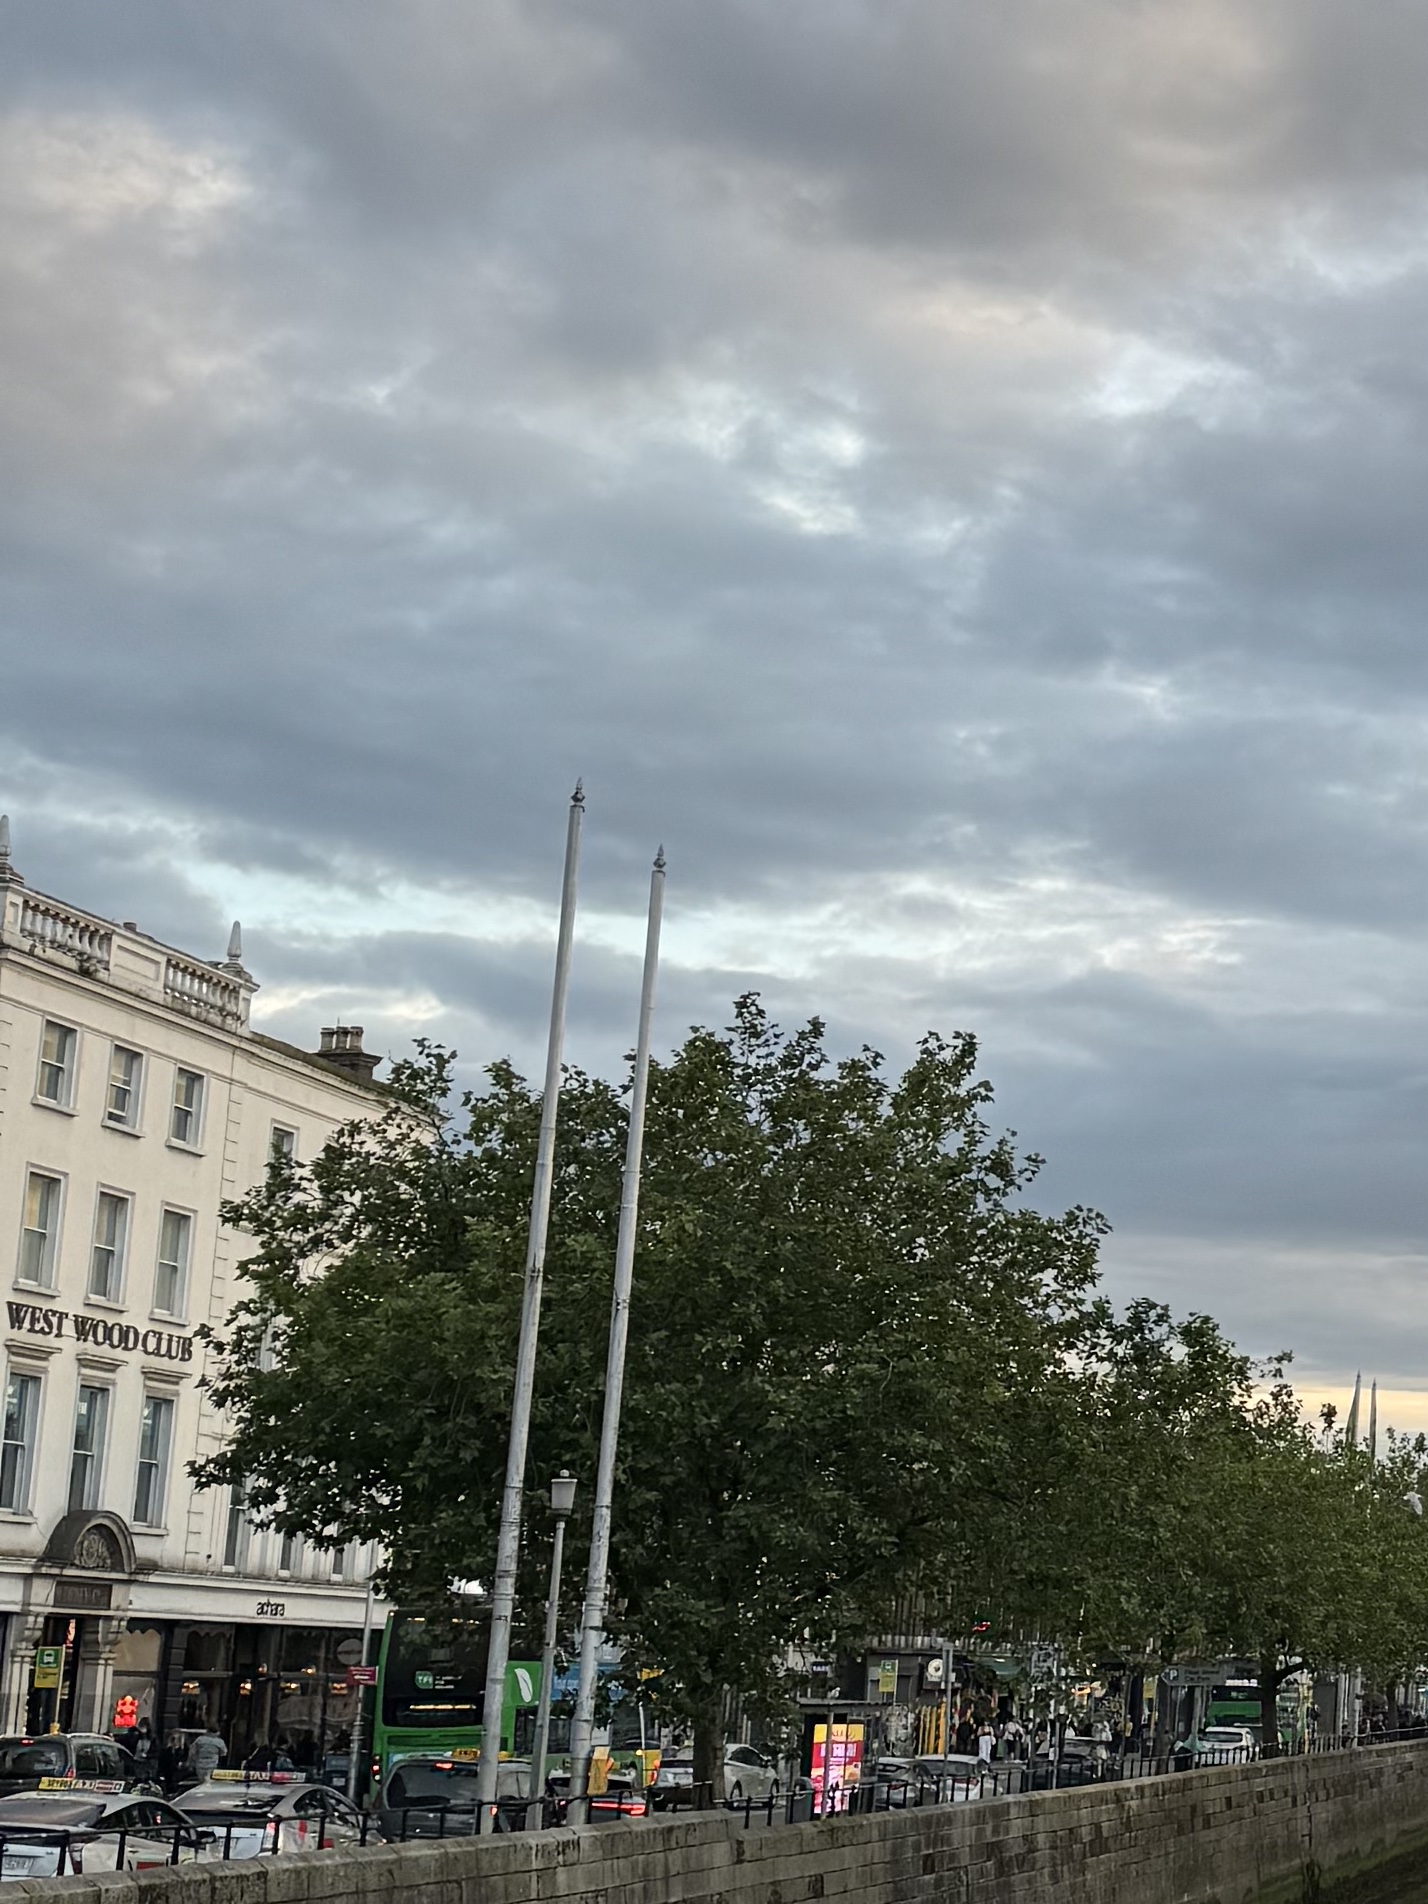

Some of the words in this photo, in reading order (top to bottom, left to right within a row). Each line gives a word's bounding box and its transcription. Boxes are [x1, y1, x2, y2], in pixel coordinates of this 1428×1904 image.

[6, 1301, 68, 1338] WEST
[73, 1314, 139, 1352] WOOD
[142, 1329, 193, 1362] CLUB
